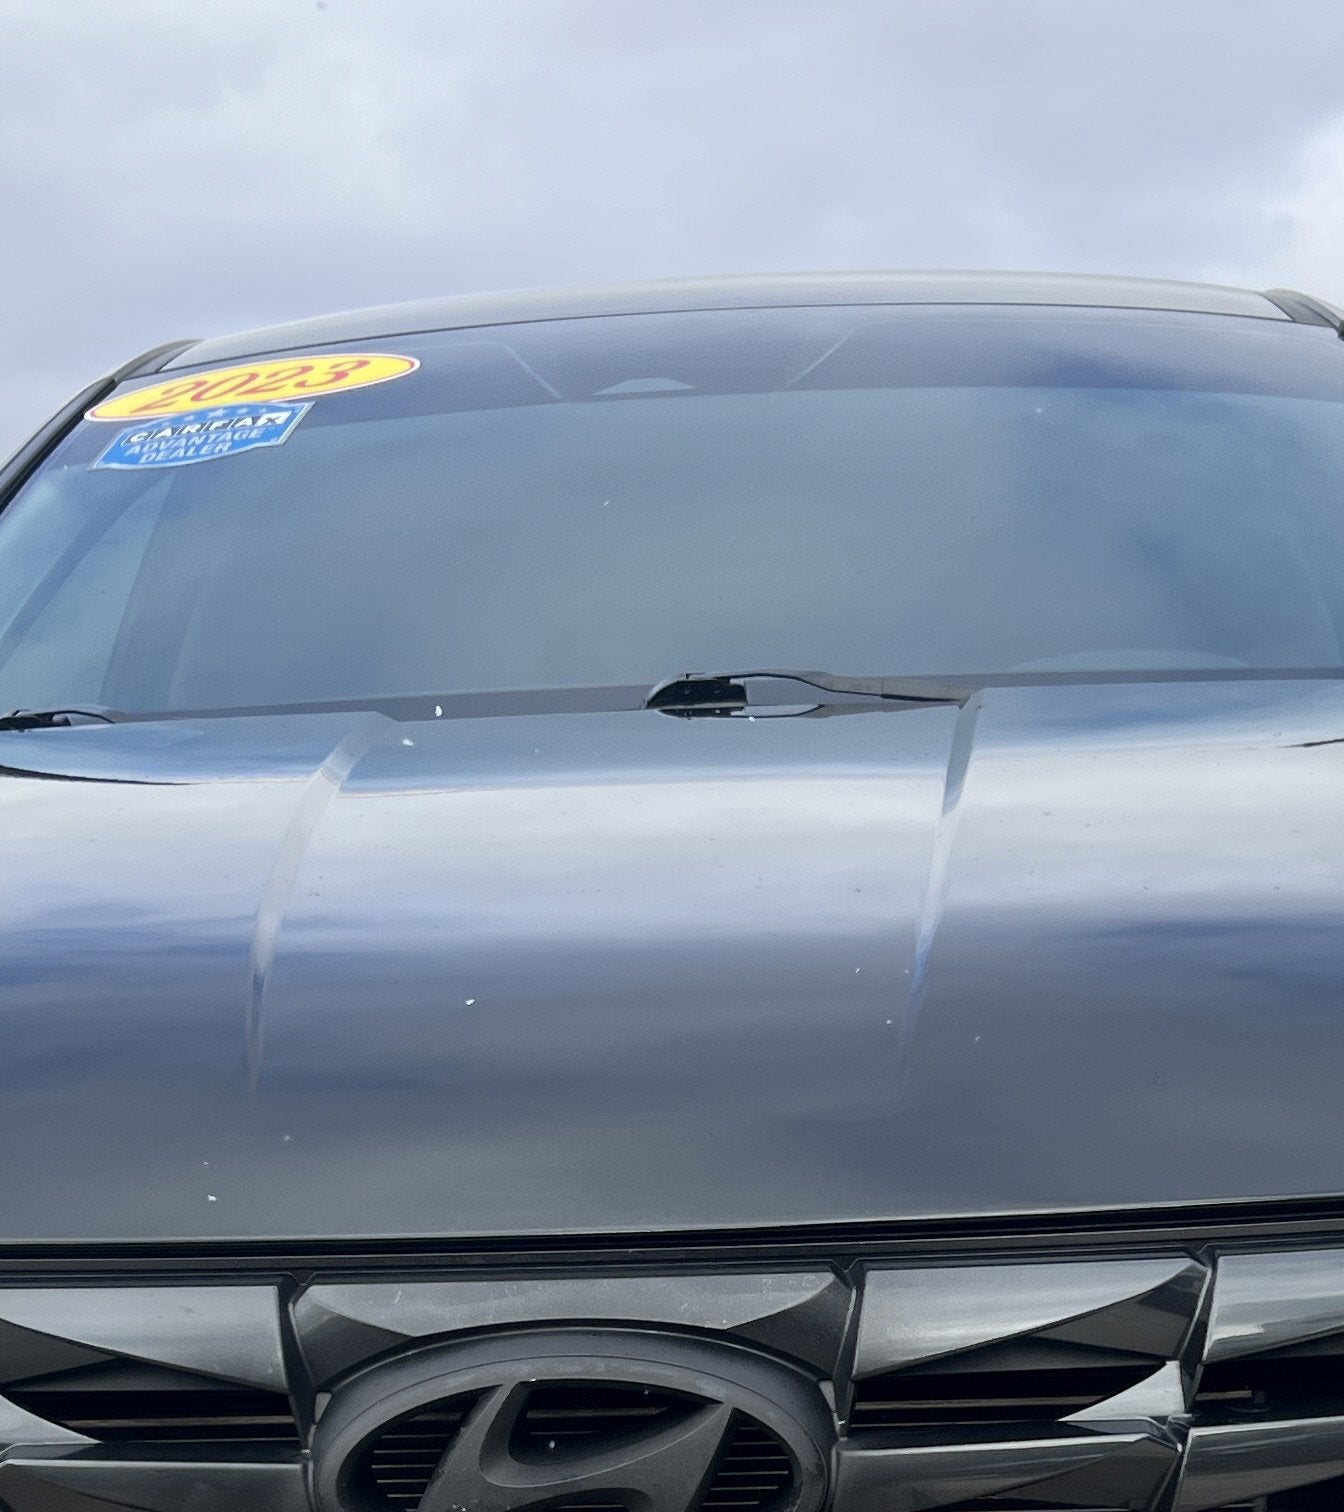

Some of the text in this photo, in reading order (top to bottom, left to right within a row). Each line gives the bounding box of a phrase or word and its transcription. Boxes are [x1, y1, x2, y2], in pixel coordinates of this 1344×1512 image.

[129, 359, 371, 414] 2023
[124, 428, 264, 457] ADVANTAGE
[128, 414, 284, 444] CARFAX
[138, 441, 233, 464] DEALER
